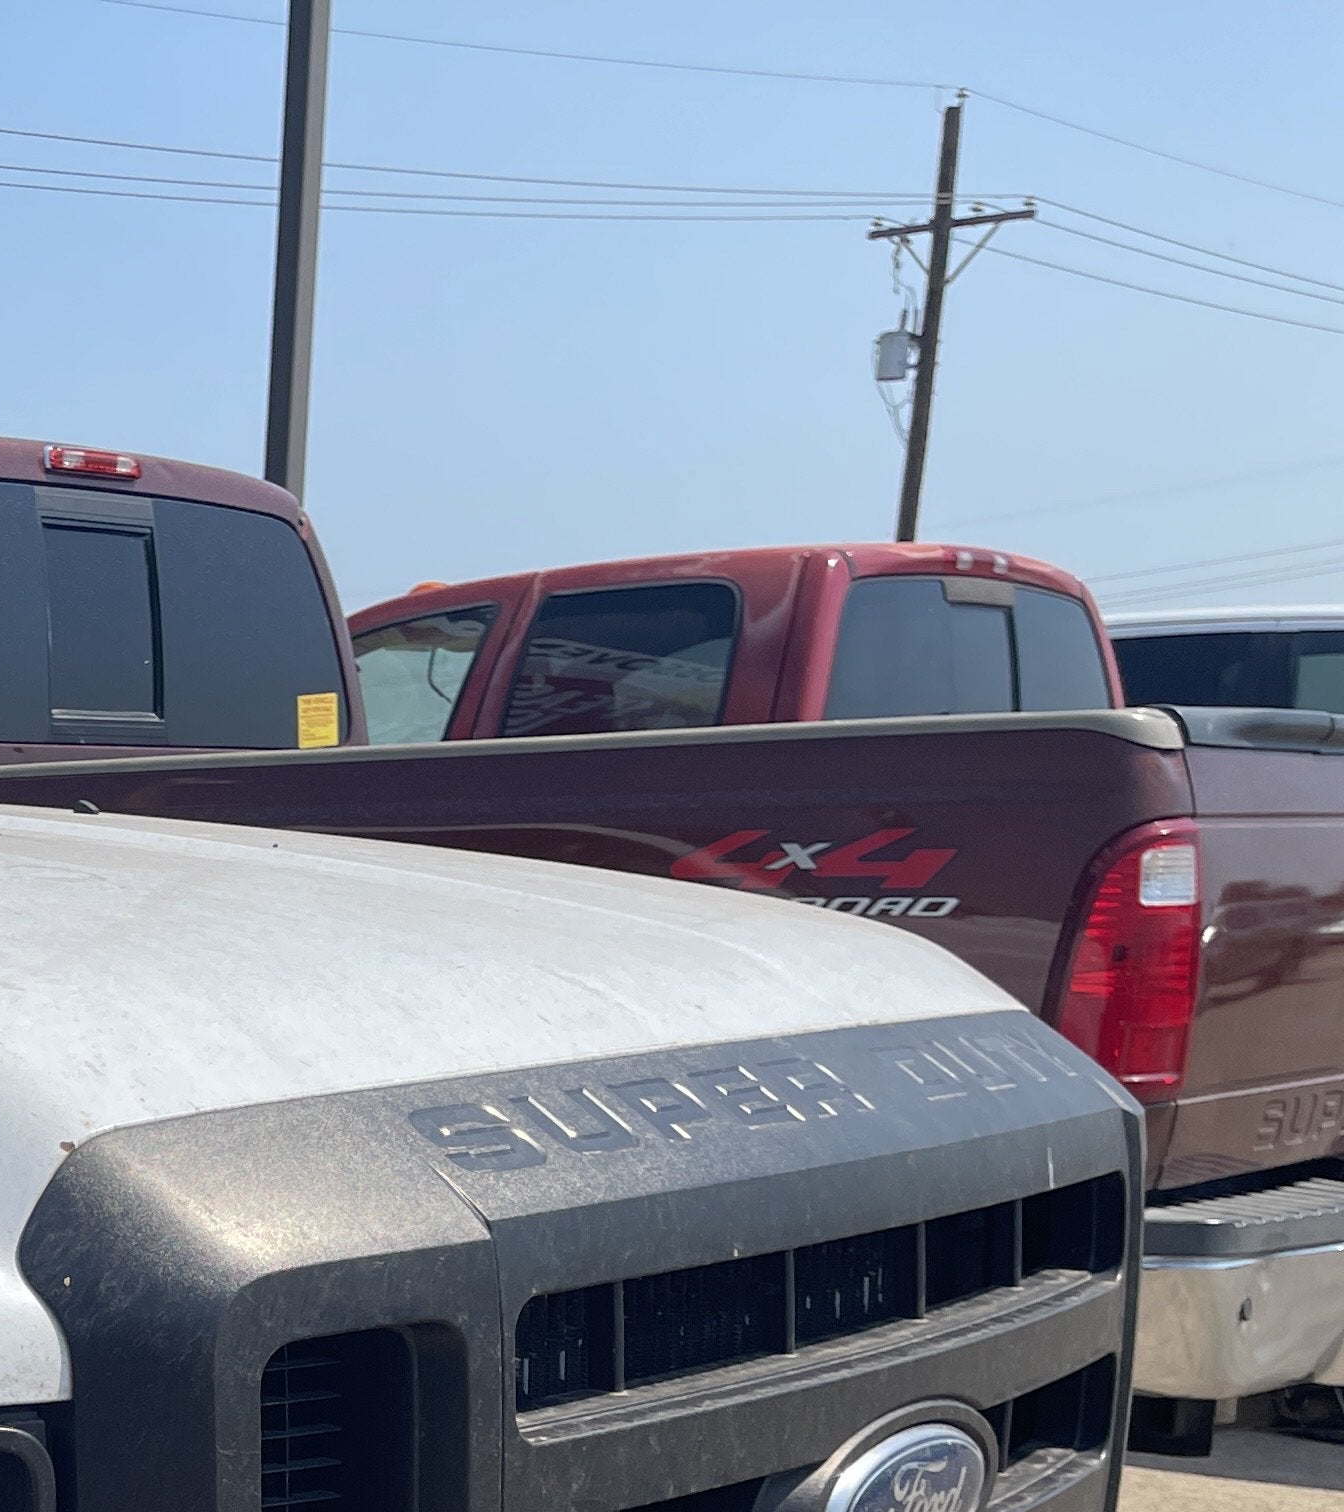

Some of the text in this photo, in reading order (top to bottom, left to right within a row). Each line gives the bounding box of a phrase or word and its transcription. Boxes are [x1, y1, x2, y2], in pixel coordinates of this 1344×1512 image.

[409, 1030, 1081, 1173] SUPER DUTY
[1252, 1088, 1344, 1153] SUP
